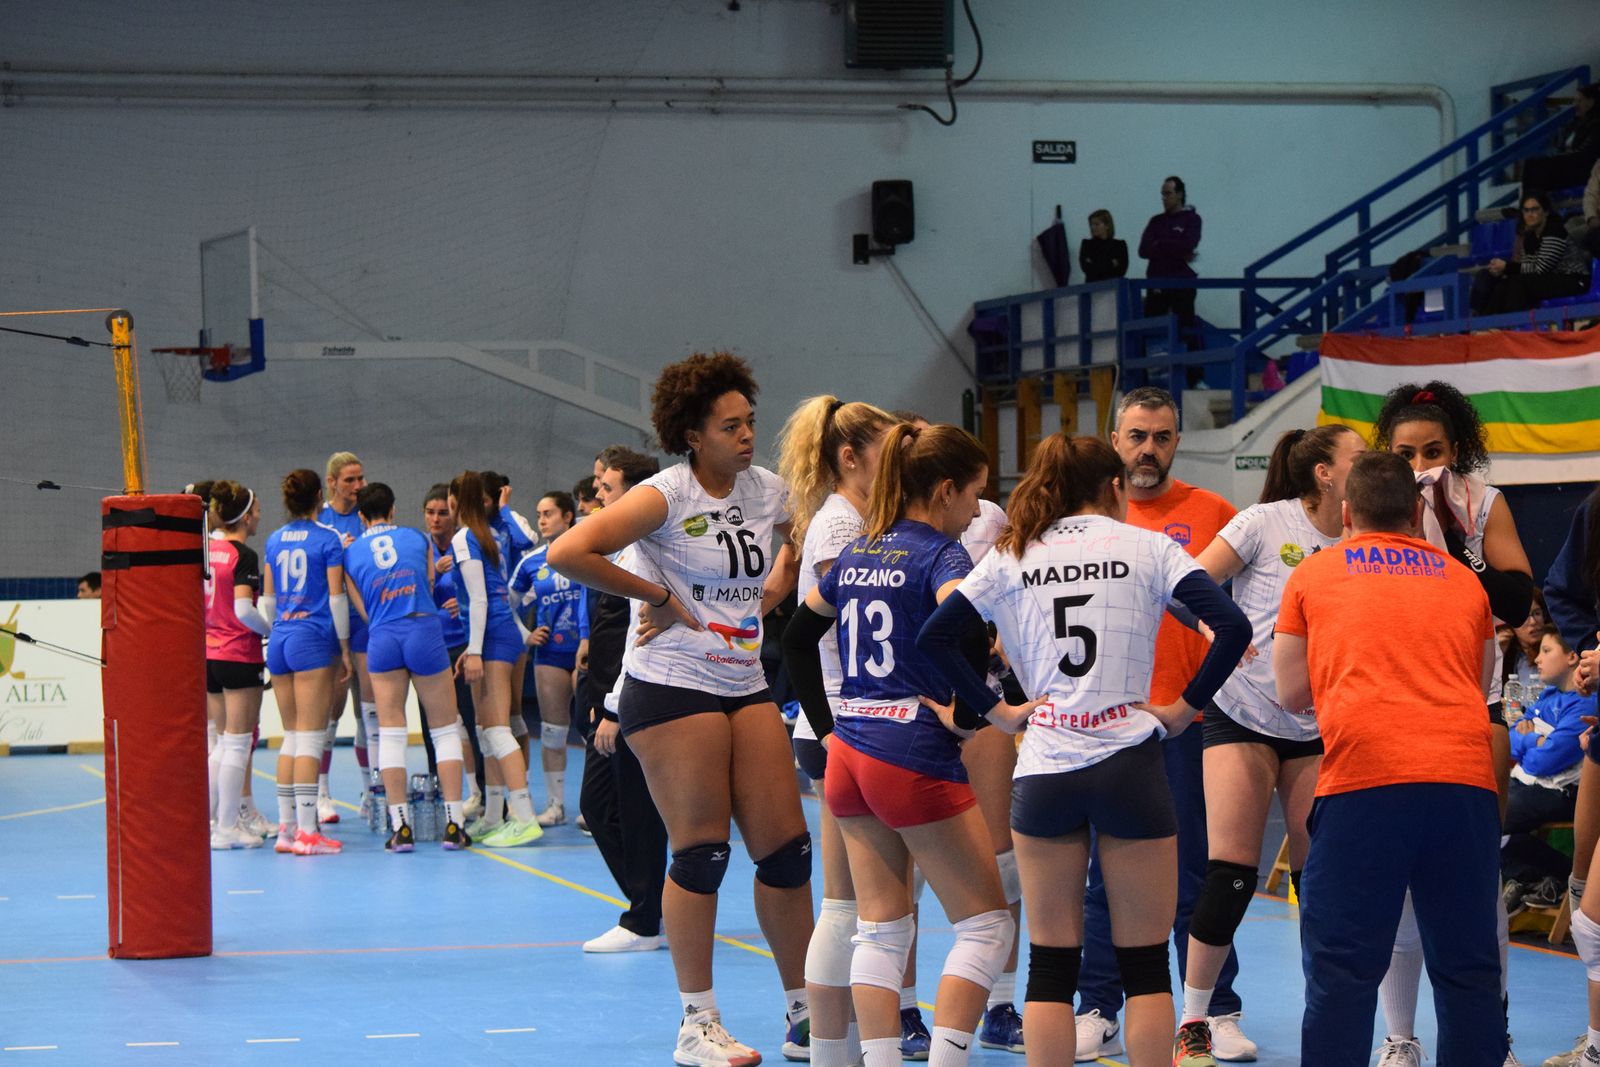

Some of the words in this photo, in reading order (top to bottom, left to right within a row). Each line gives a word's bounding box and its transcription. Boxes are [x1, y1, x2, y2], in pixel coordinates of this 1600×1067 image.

[1035, 143, 1073, 155] SALIDA
[281, 530, 309, 542] BRAVO
[370, 534, 398, 569] 8
[716, 529, 765, 579] 16
[1345, 546, 1445, 569] MADRID
[276, 548, 308, 593] 19
[838, 567, 906, 588] LOZANO
[1021, 560, 1130, 589] MADRID
[1348, 564, 1382, 575] CLUB
[841, 598, 896, 677] 13
[1053, 593, 1098, 678] 5
[6, 684, 67, 702] ALTA
